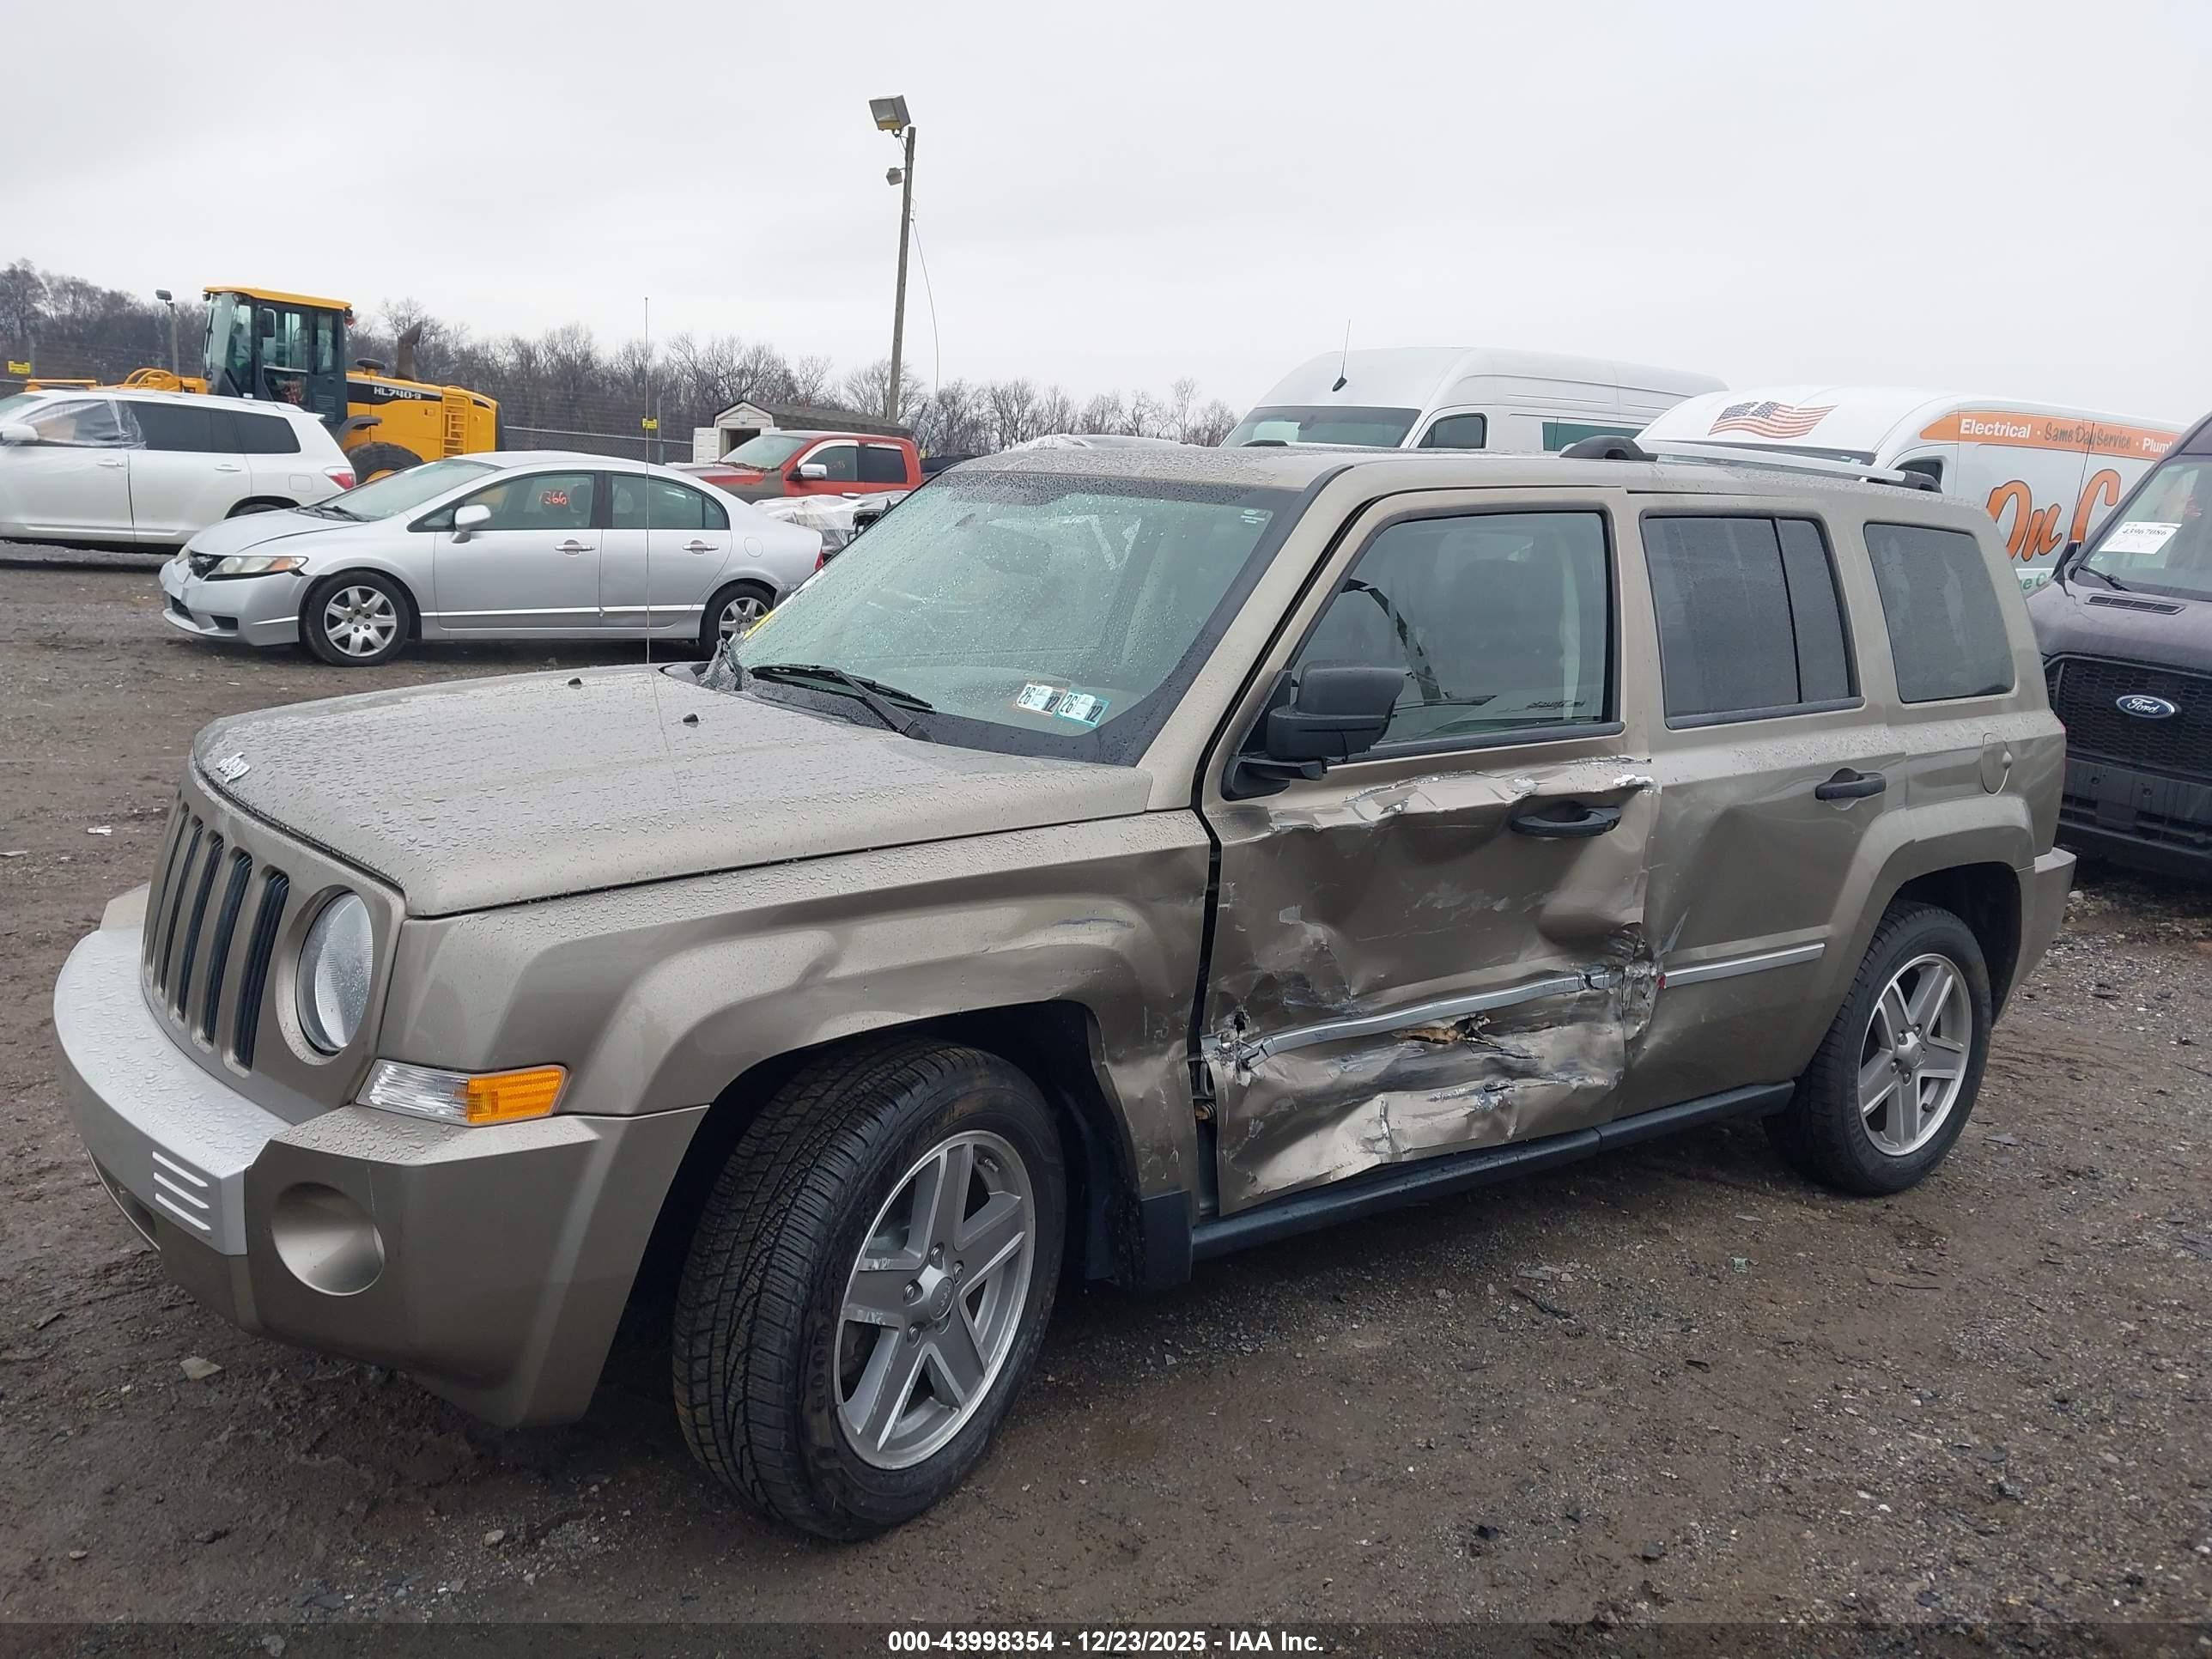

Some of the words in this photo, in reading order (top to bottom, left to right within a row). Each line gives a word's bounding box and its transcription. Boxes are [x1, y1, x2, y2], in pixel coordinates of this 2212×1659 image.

[374, 386, 422, 400] HL740-9
[1960, 418, 2032, 439] Electrical
[2045, 422, 2074, 443] Same
[2075, 425, 2095, 450] Day
[2097, 428, 2131, 450] Service
[1018, 686, 1036, 705] 26
[1042, 696, 1060, 713] 12
[1060, 694, 1079, 714] 26
[1085, 705, 1103, 723] 12
[2126, 697, 2160, 714] Ford
